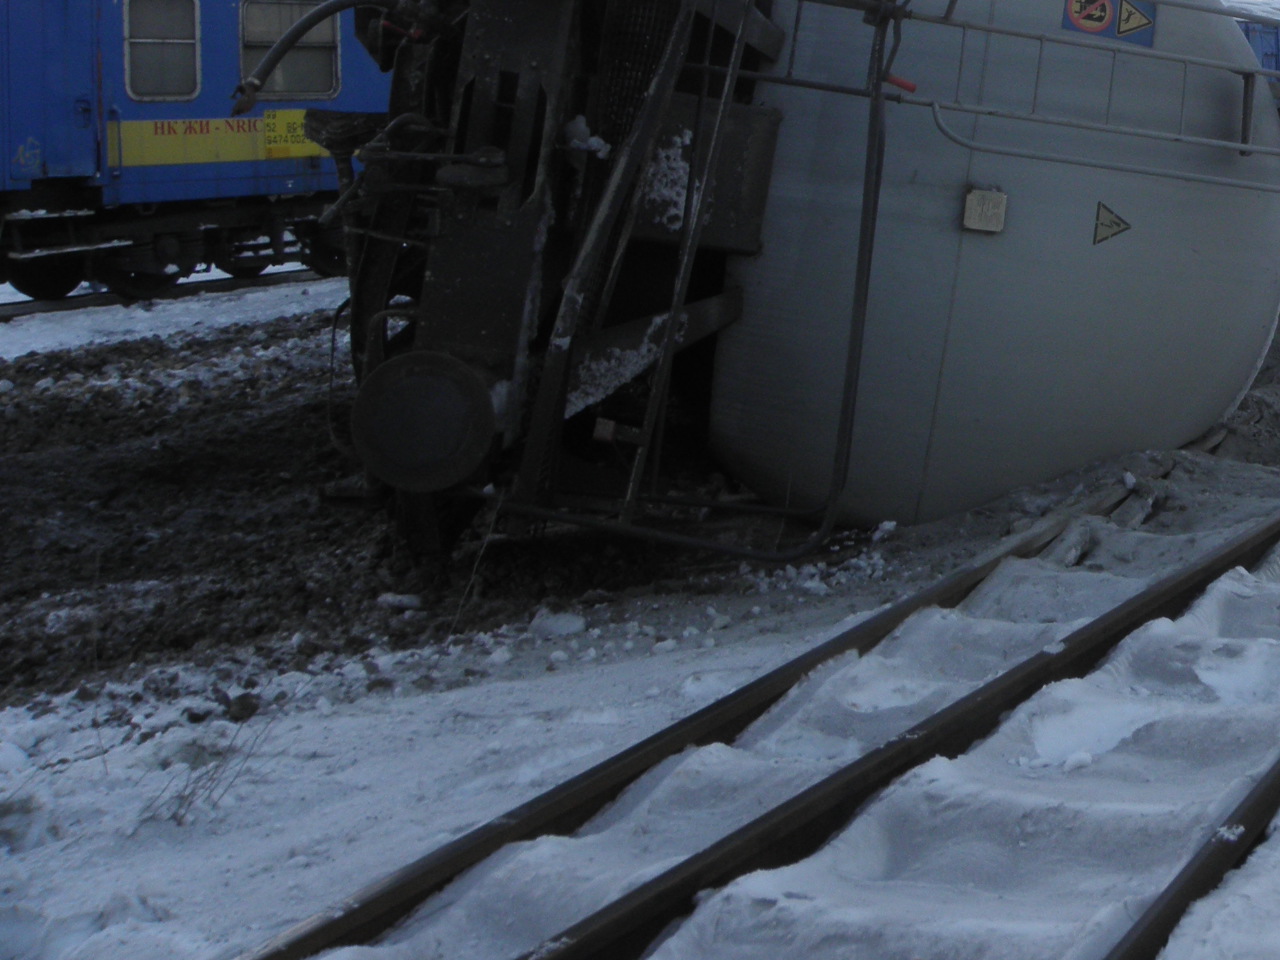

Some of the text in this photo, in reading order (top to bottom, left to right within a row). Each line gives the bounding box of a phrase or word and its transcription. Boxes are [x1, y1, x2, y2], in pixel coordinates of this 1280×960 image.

[154, 120, 178, 136] НК
[183, 119, 210, 135] ЖИ
[224, 118, 263, 133] NRIC
